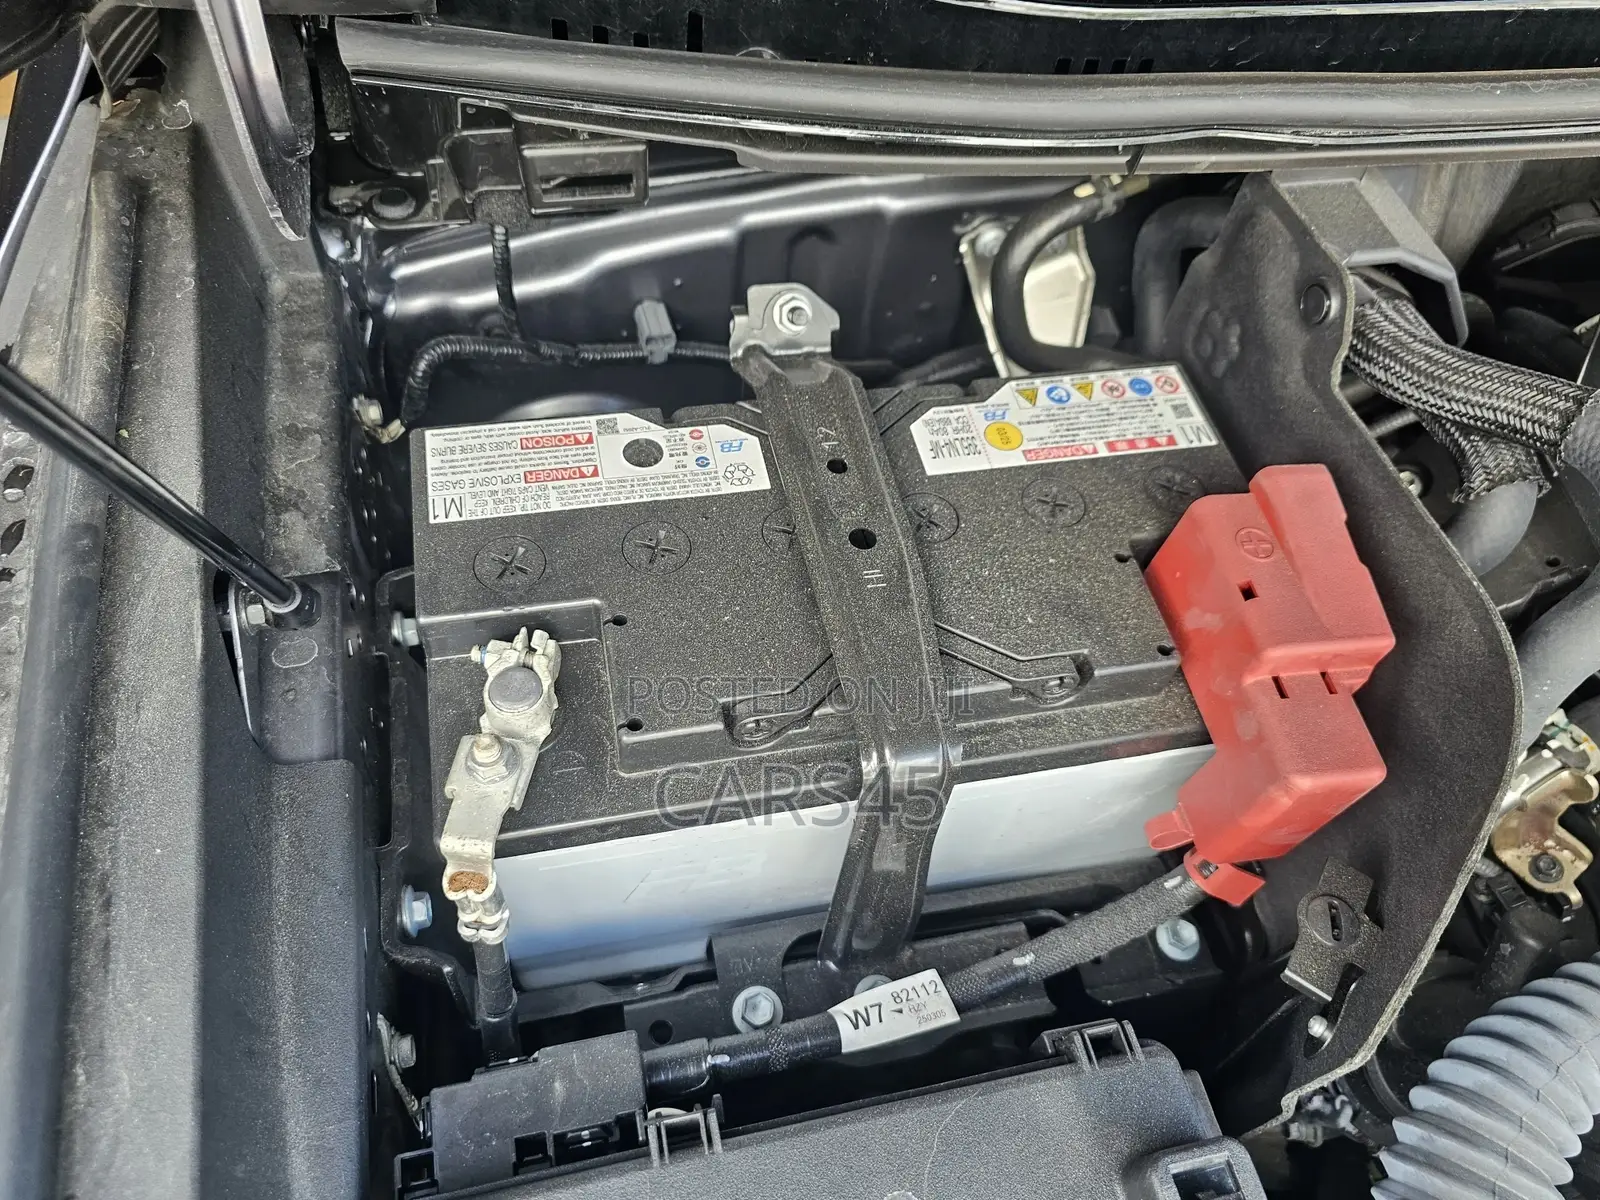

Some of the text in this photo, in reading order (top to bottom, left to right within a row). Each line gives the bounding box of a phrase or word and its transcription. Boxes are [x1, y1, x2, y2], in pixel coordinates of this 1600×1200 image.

[1180, 424, 1213, 444] M1
[521, 434, 575, 448] POISON
[430, 439, 518, 457] CAUSES SEVERE BURNS
[524, 467, 580, 482] DANGER
[431, 473, 521, 491] EXPLOSIVE GASES
[500, 487, 516, 496] TIGHT
[517, 485, 532, 494] CAPS
[534, 483, 549, 492] VENT
[487, 488, 499, 497] AND
[530, 492, 549, 501] REACH
[473, 498, 488, 507] KEEP
[521, 494, 529, 502] OF
[432, 495, 462, 520] M1
[502, 504, 516, 513] KEEP
[529, 502, 540, 510] NOT
[542, 501, 550, 509] DO
[468, 508, 478, 516] THE
[479, 507, 487, 515] OF
[489, 506, 500, 514] OUT
[890, 979, 942, 1005] 82112
[843, 1002, 883, 1031] W7
